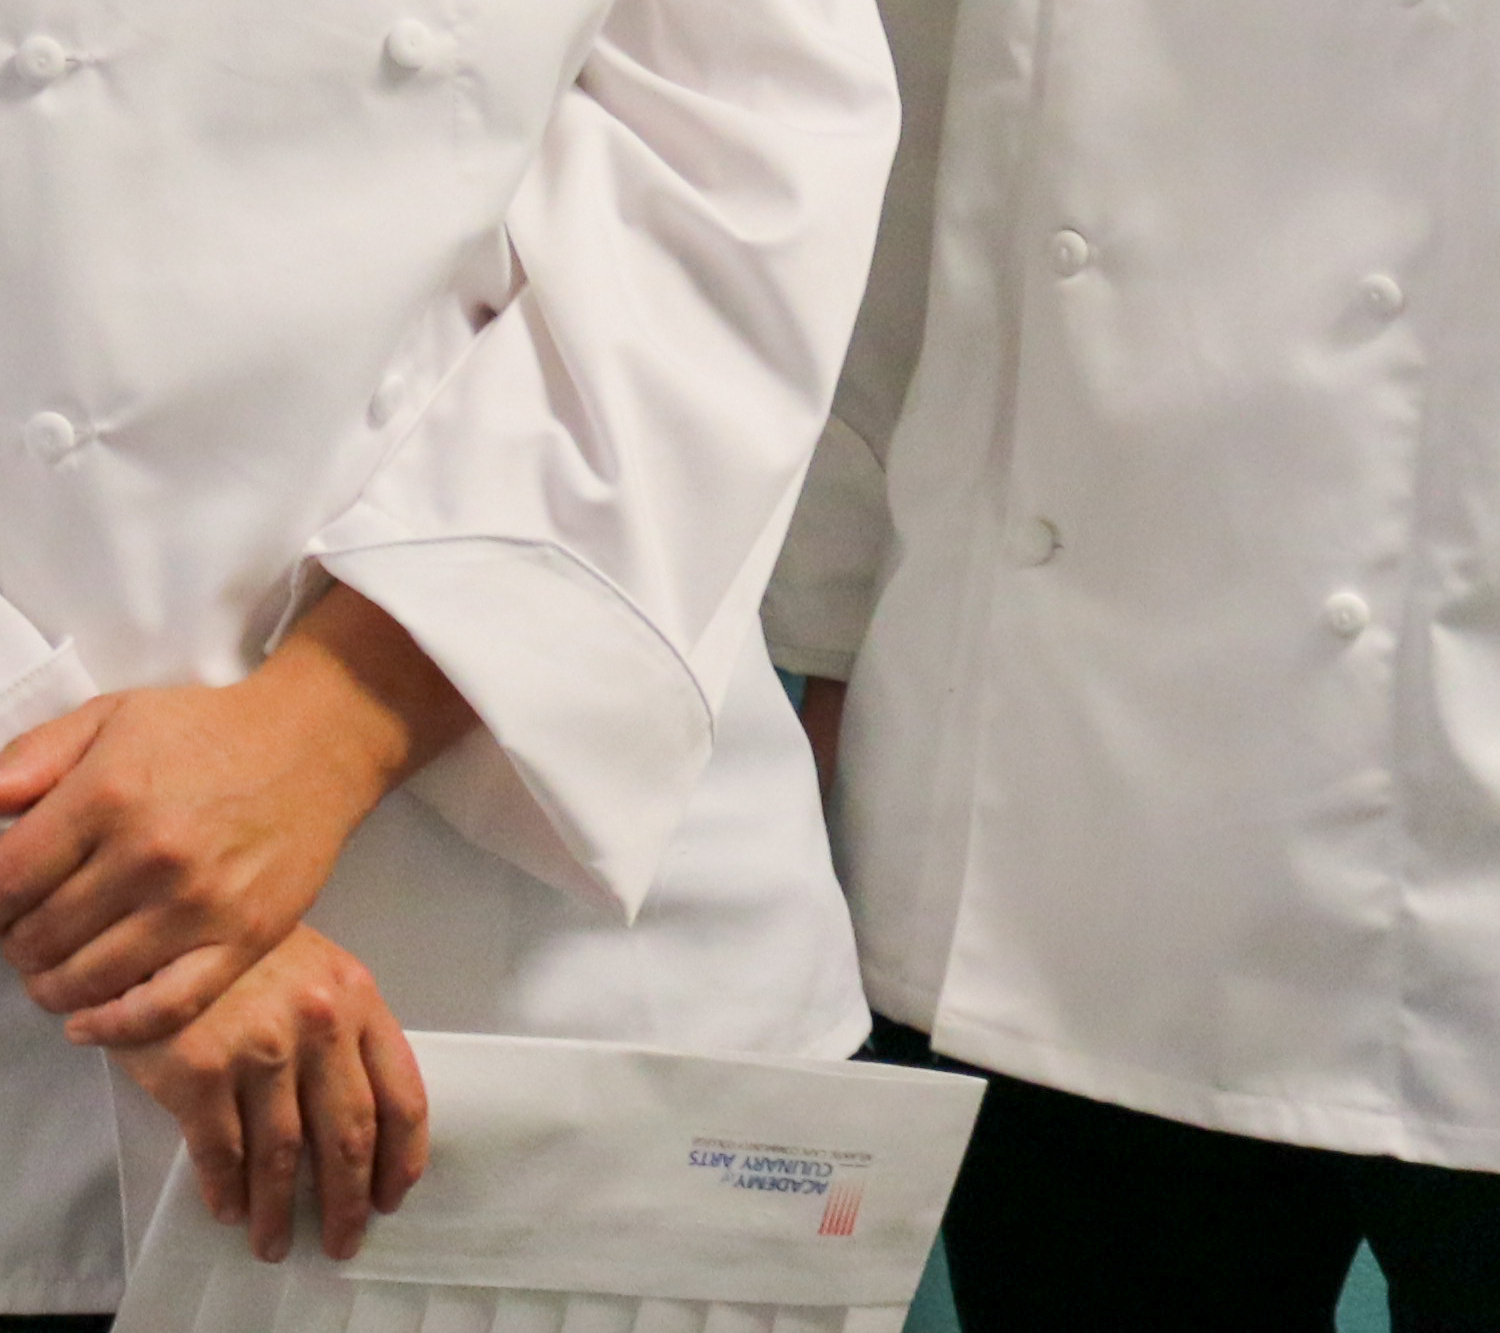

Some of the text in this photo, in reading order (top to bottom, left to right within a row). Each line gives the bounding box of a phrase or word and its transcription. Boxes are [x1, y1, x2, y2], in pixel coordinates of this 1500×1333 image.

[689, 1150, 833, 1178] CULINARY ARTS
[733, 1175, 829, 1196] ACADEMY
